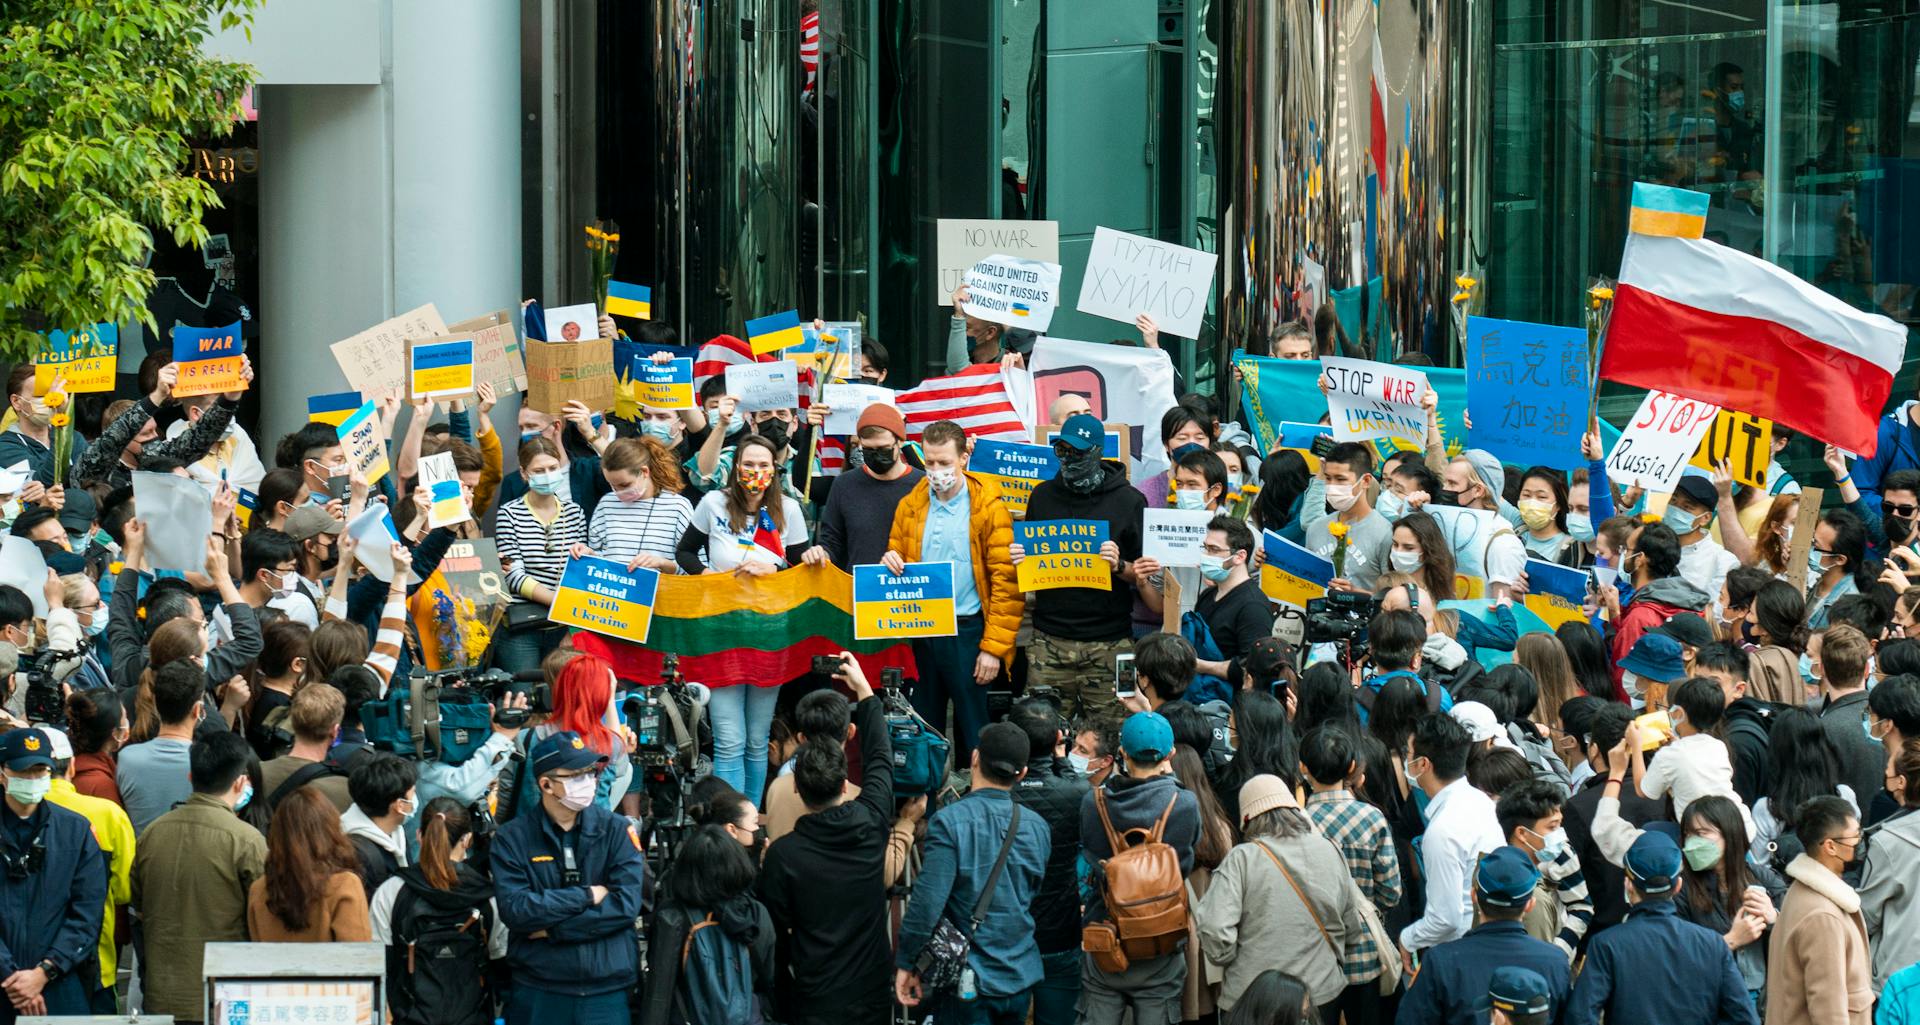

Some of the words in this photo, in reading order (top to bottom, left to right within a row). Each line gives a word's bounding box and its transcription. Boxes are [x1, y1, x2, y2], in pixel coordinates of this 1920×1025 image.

[965, 229, 986, 247] NO
[990, 228, 1038, 248] WAR
[1113, 237, 1193, 274] ПУТИН
[972, 263, 1004, 278] WORLD
[1007, 268, 1038, 284] UNITED
[970, 278, 1008, 296] AGAINST
[1009, 286, 1049, 303] RUSSIA'S
[1090, 265, 1195, 320] ХУЙЛО
[71, 333, 90, 346] NO
[199, 335, 234, 352] WAR
[73, 361, 101, 372] WAR
[183, 366, 196, 377] IS
[202, 364, 232, 375] REAL
[641, 364, 678, 373] Taiwan
[645, 373, 673, 383] stand
[179, 383, 208, 393] ACTION
[210, 379, 238, 390] NEEDED
[648, 384, 671, 393] with
[1326, 367, 1373, 397] STOP
[1383, 376, 1416, 405] WAR
[642, 393, 679, 403] Ukraine
[1373, 401, 1394, 413] IN
[1636, 392, 1717, 436] STOP
[1501, 395, 1571, 436] 加油
[1346, 409, 1423, 442] UKRAINE
[352, 422, 372, 444] STAND
[353, 438, 372, 457] WITH
[1692, 414, 1765, 485] UT.
[994, 449, 1048, 465] Taiwan
[1608, 439, 1684, 484] Russia!
[998, 466, 1038, 478] stand
[1000, 478, 1034, 492] with
[1024, 525, 1097, 538] UKRAINE
[1033, 543, 1050, 554] IS
[1059, 541, 1093, 553] NOT
[1038, 557, 1093, 570] ALONE
[586, 565, 637, 587] Taiwan
[877, 574, 930, 585] Taiwan
[1032, 575, 1069, 585] ACTION
[1074, 575, 1107, 585] NEEDED
[587, 583, 627, 599] stand
[885, 587, 924, 600] stand
[588, 598, 620, 612] with
[890, 603, 922, 614] with
[572, 607, 628, 630] Ukraine
[877, 618, 935, 629] Ukraine
